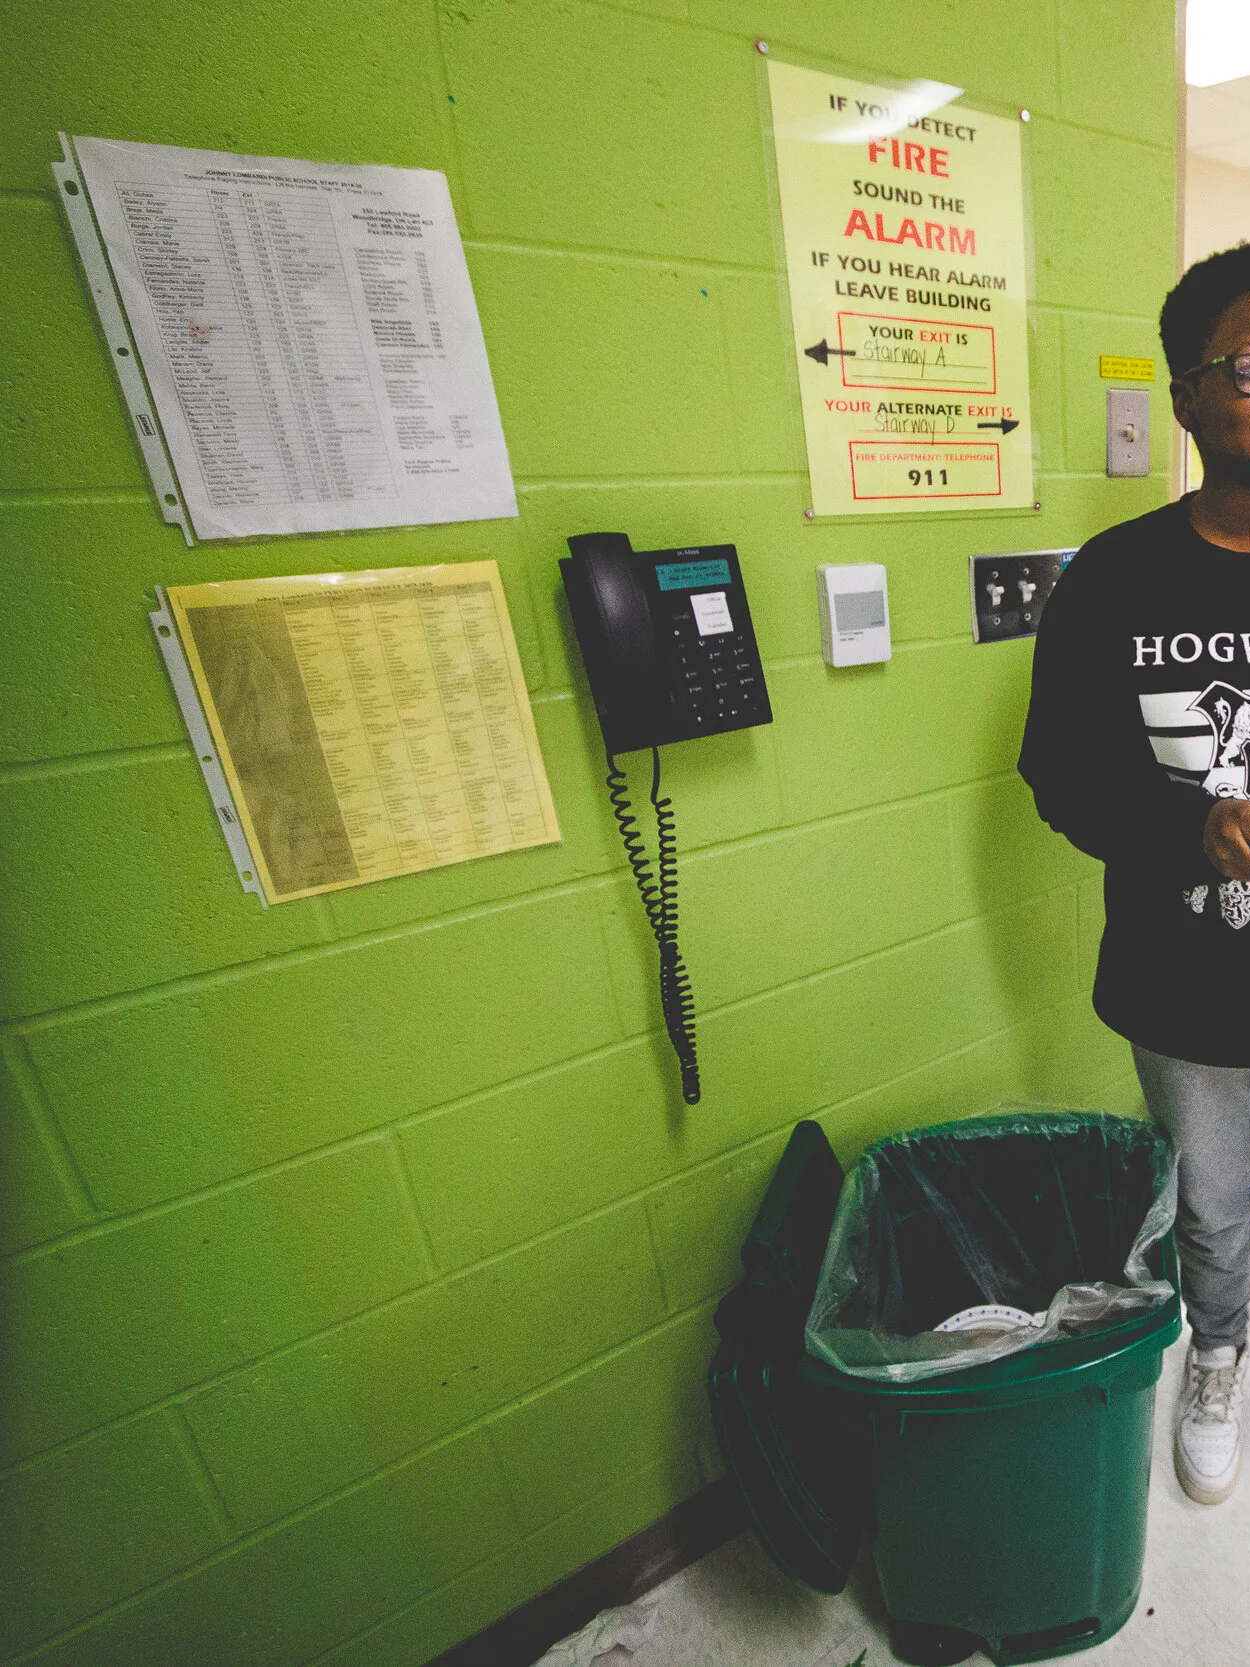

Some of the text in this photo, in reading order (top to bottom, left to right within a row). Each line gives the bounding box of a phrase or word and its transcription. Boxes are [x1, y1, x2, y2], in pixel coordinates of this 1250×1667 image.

[829, 94, 847, 111] IF
[908, 116, 976, 142] DETECT
[868, 136, 950, 179] FIRE
[853, 180, 965, 214] SOUND THE
[843, 208, 977, 257] ALARM
[811, 251, 1006, 291] IF YOU HEAR ALARM
[835, 279, 991, 313] LEAVE BUILDING
[869, 325, 968, 345] YOUR EXIT IS
[863, 339, 946, 378] Stairway A
[824, 399, 1013, 418] YOUR ALTERNATE EXIT IS
[874, 413, 956, 446] Stairway D
[856, 453, 876, 461] FIRE
[908, 469, 948, 486] 911
